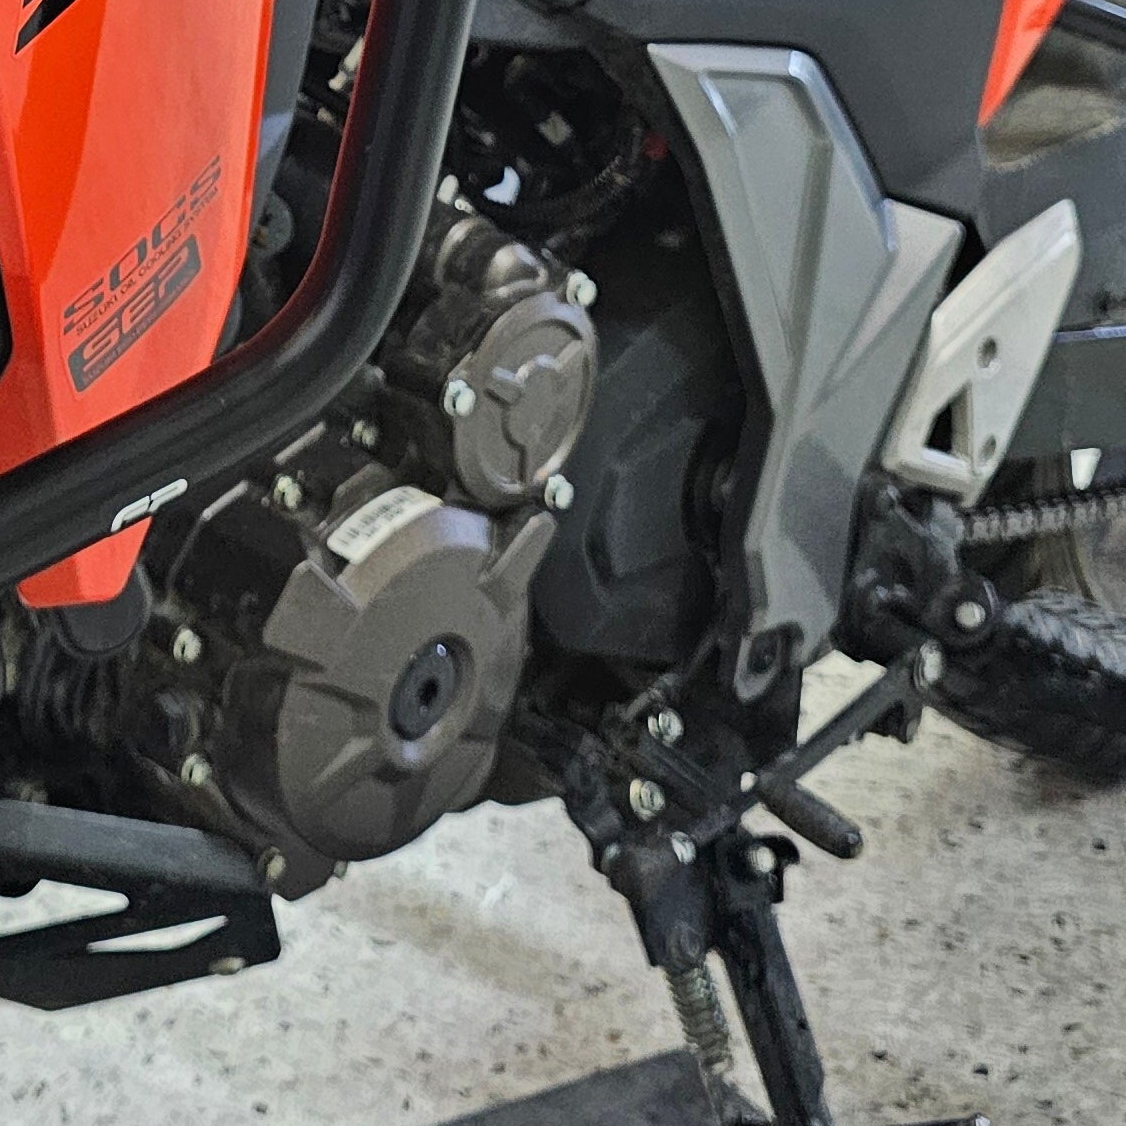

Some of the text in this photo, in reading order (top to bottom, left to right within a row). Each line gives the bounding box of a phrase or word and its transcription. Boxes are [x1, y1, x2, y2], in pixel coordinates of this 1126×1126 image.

[63, 155, 221, 335] SOCS
[76, 296, 119, 337] SUZUKI
[120, 279, 136, 294] OIL
[82, 246, 190, 373] SEP
